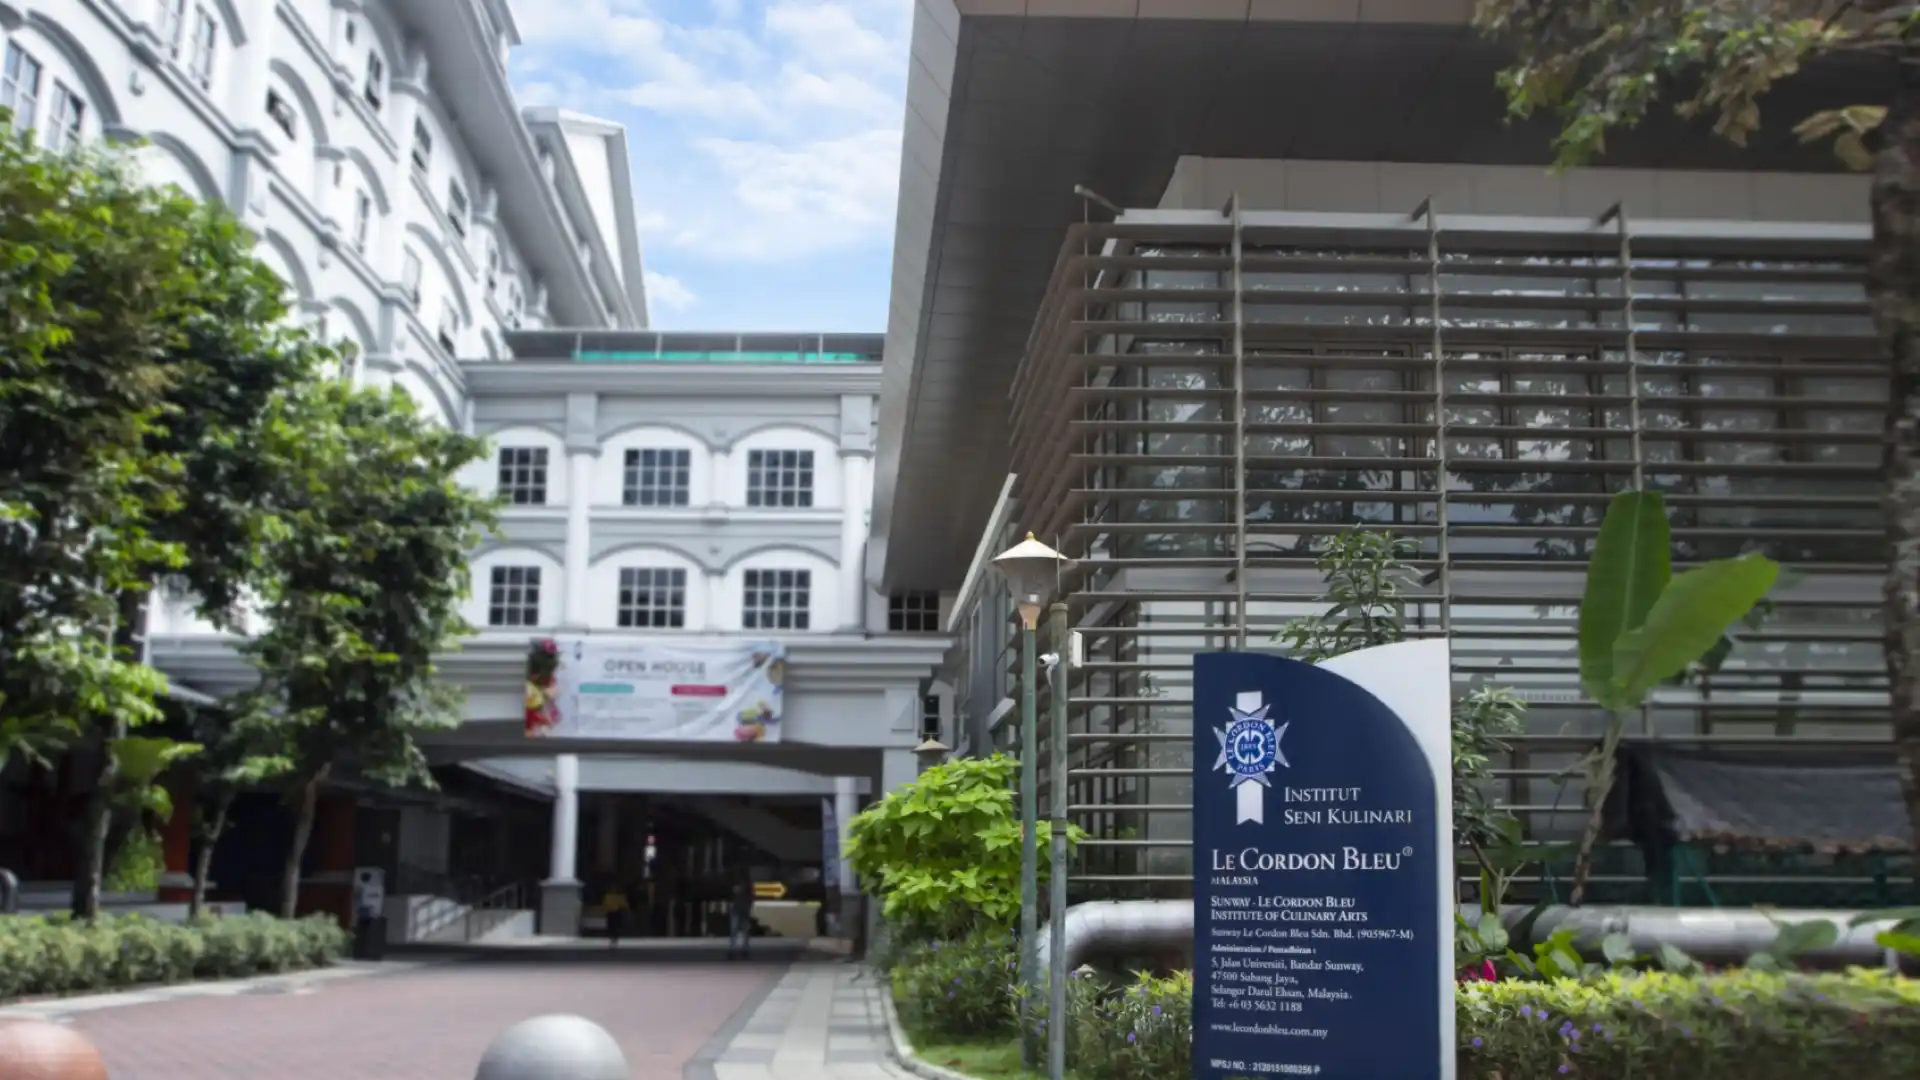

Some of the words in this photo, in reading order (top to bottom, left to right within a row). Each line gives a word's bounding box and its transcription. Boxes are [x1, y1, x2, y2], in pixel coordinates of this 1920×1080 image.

[604, 659, 647, 672] OPEN
[651, 660, 706, 675] HOUSE
[1284, 787, 1362, 802] INSTITUT
[1284, 809, 1321, 825] SENI
[1327, 808, 1412, 824] KULINARI
[1212, 849, 1236, 871] LE
[1240, 847, 1336, 871] CORDON
[1211, 875, 1259, 886] MALAYSIA
[1211, 895, 1251, 907] SUNWAY
[1273, 895, 1323, 908] CORDON
[1325, 896, 1356, 909] BLEU
[1211, 909, 1263, 921] INSTITUTE
[1264, 910, 1279, 921] OF
[1281, 909, 1337, 921] CULINARY
[1338, 910, 1368, 921] ARTS
[1211, 927, 1241, 939] Sunway
[1243, 927, 1253, 937] Le
[1255, 928, 1287, 938] Cordon
[1290, 928, 1309, 938] Bleu
[1311, 928, 1331, 938] Sdn.
[1333, 928, 1354, 939] Bhd.
[1357, 928, 1414, 940] (905967-M)
[1220, 957, 1241, 969] Jalan
[1243, 958, 1287, 970] Universiti,
[1290, 959, 1322, 970] Bandar
[1211, 970, 1238, 980] 47500
[1240, 972, 1272, 984] Subang
[1275, 972, 1299, 985] Jaya,
[1211, 984, 1246, 997] Selangor
[1247, 985, 1273, 996] Darul
[1275, 986, 1304, 998] Ehsan,
[1308, 987, 1352, 1002] Malaysia.
[1212, 998, 1226, 1008] Tel:
[1240, 1000, 1252, 1010] 03
[1254, 1000, 1277, 1011] 5632
[1279, 1001, 1303, 1012] 1188
[1210, 1022, 1328, 1039] www.lecordonbleu.com.my
